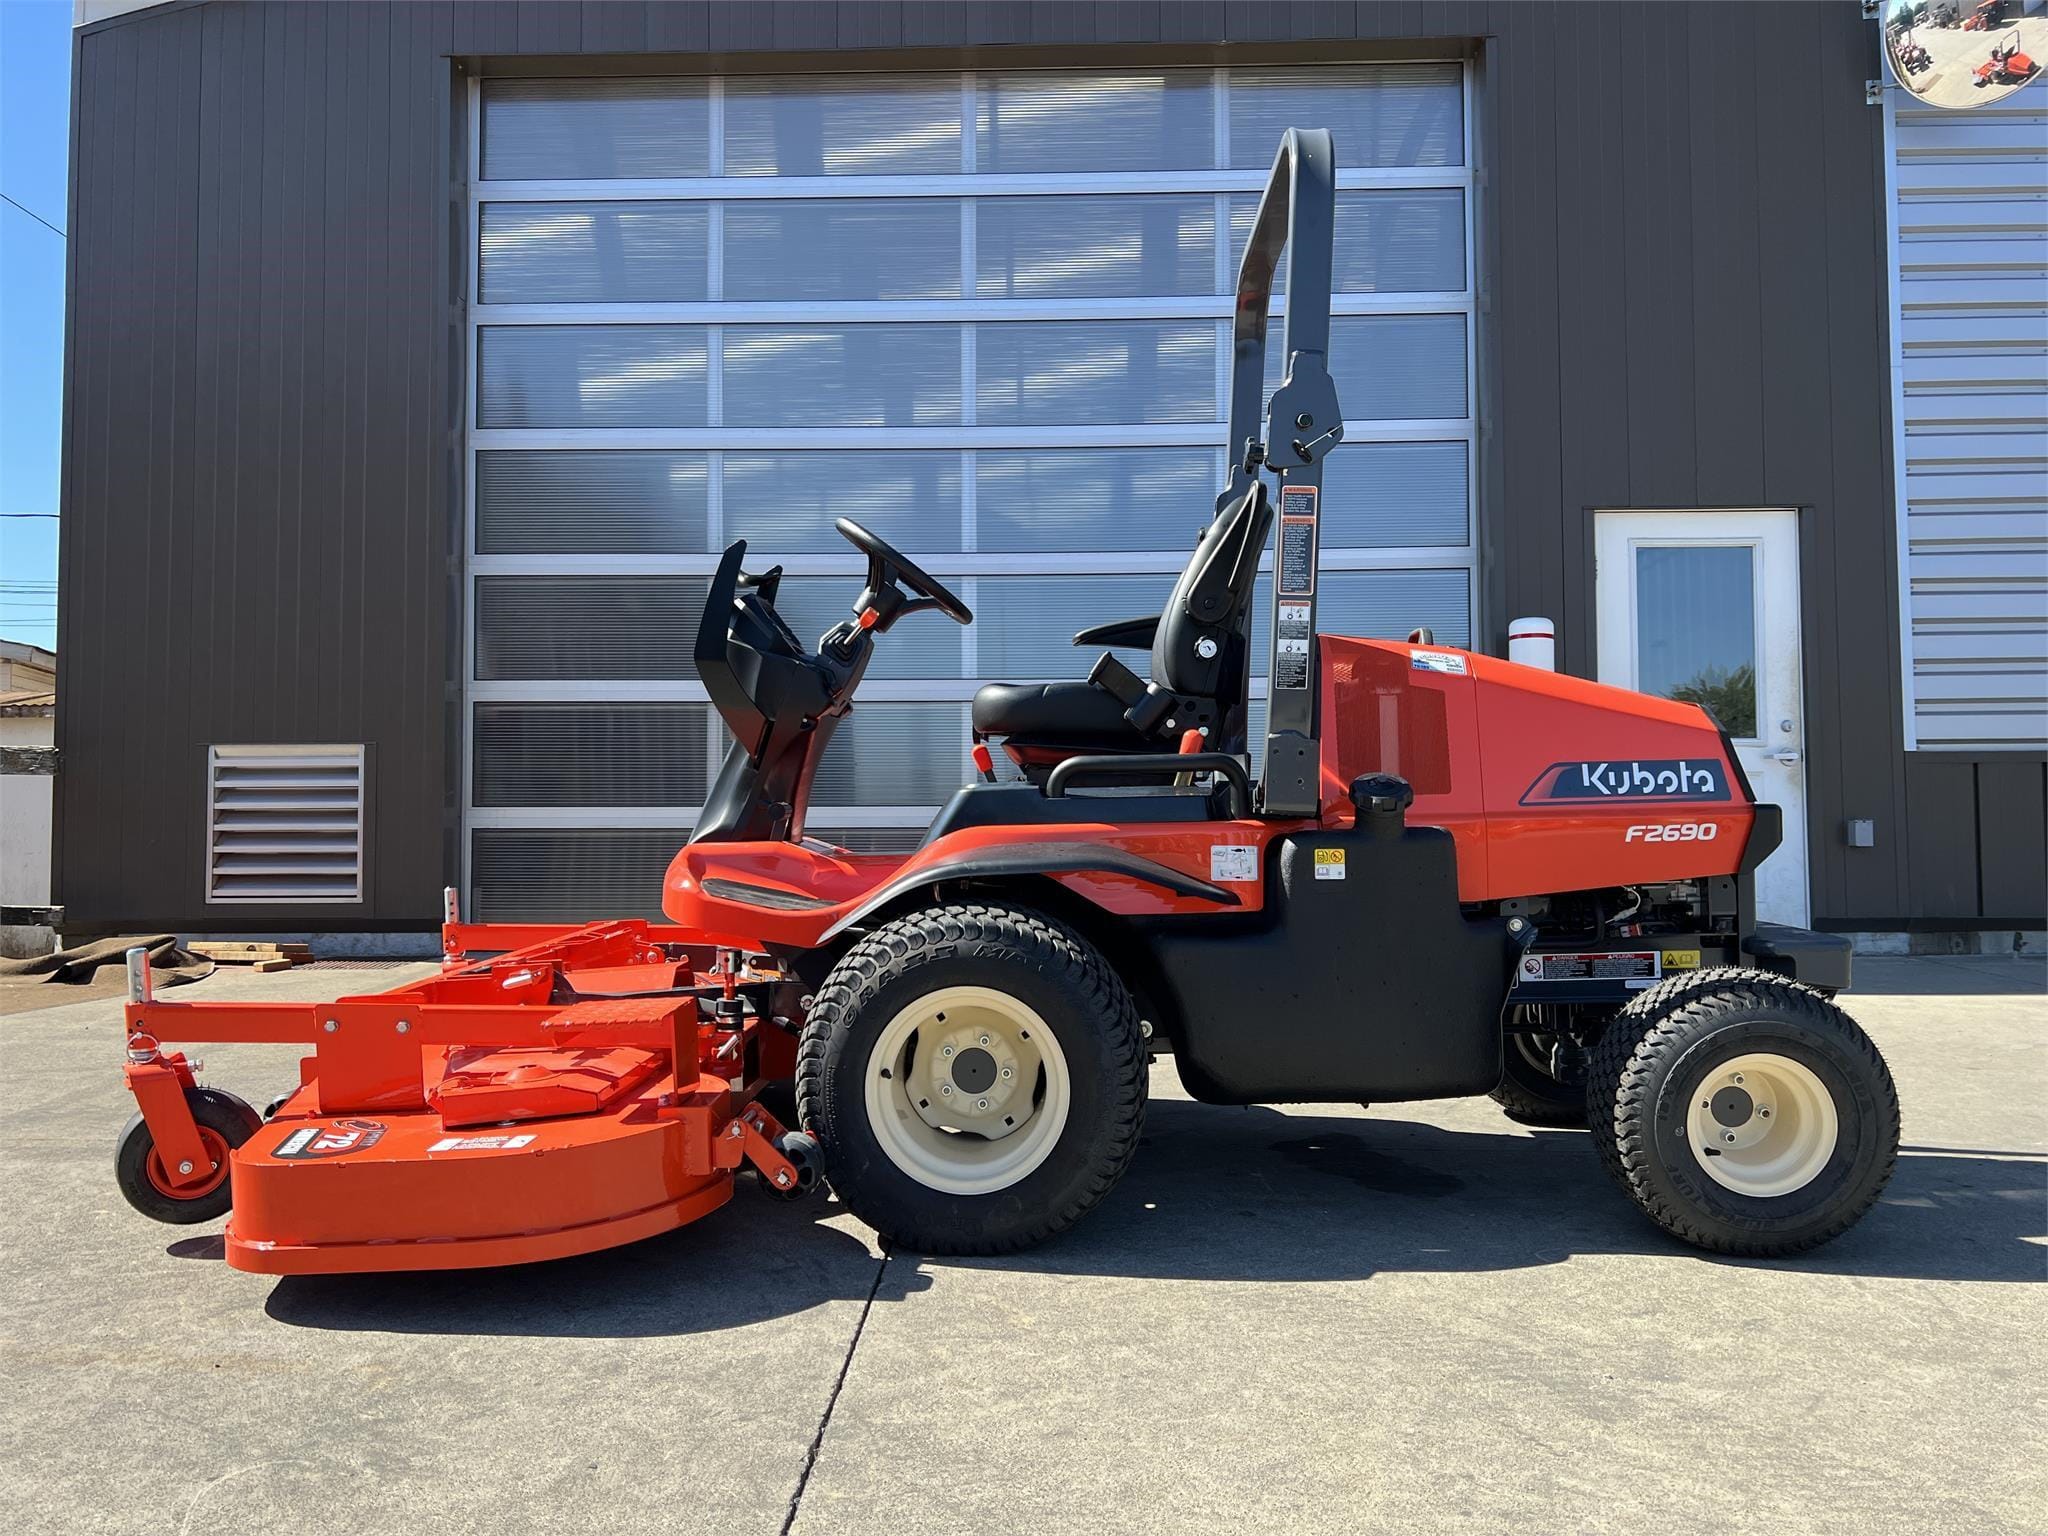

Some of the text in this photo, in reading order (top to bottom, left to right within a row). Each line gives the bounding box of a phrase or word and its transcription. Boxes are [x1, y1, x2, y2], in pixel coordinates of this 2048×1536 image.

[1581, 761, 1715, 794] Kubota
[1624, 822, 1717, 843] F2690
[313, 1131, 361, 1150] 72
